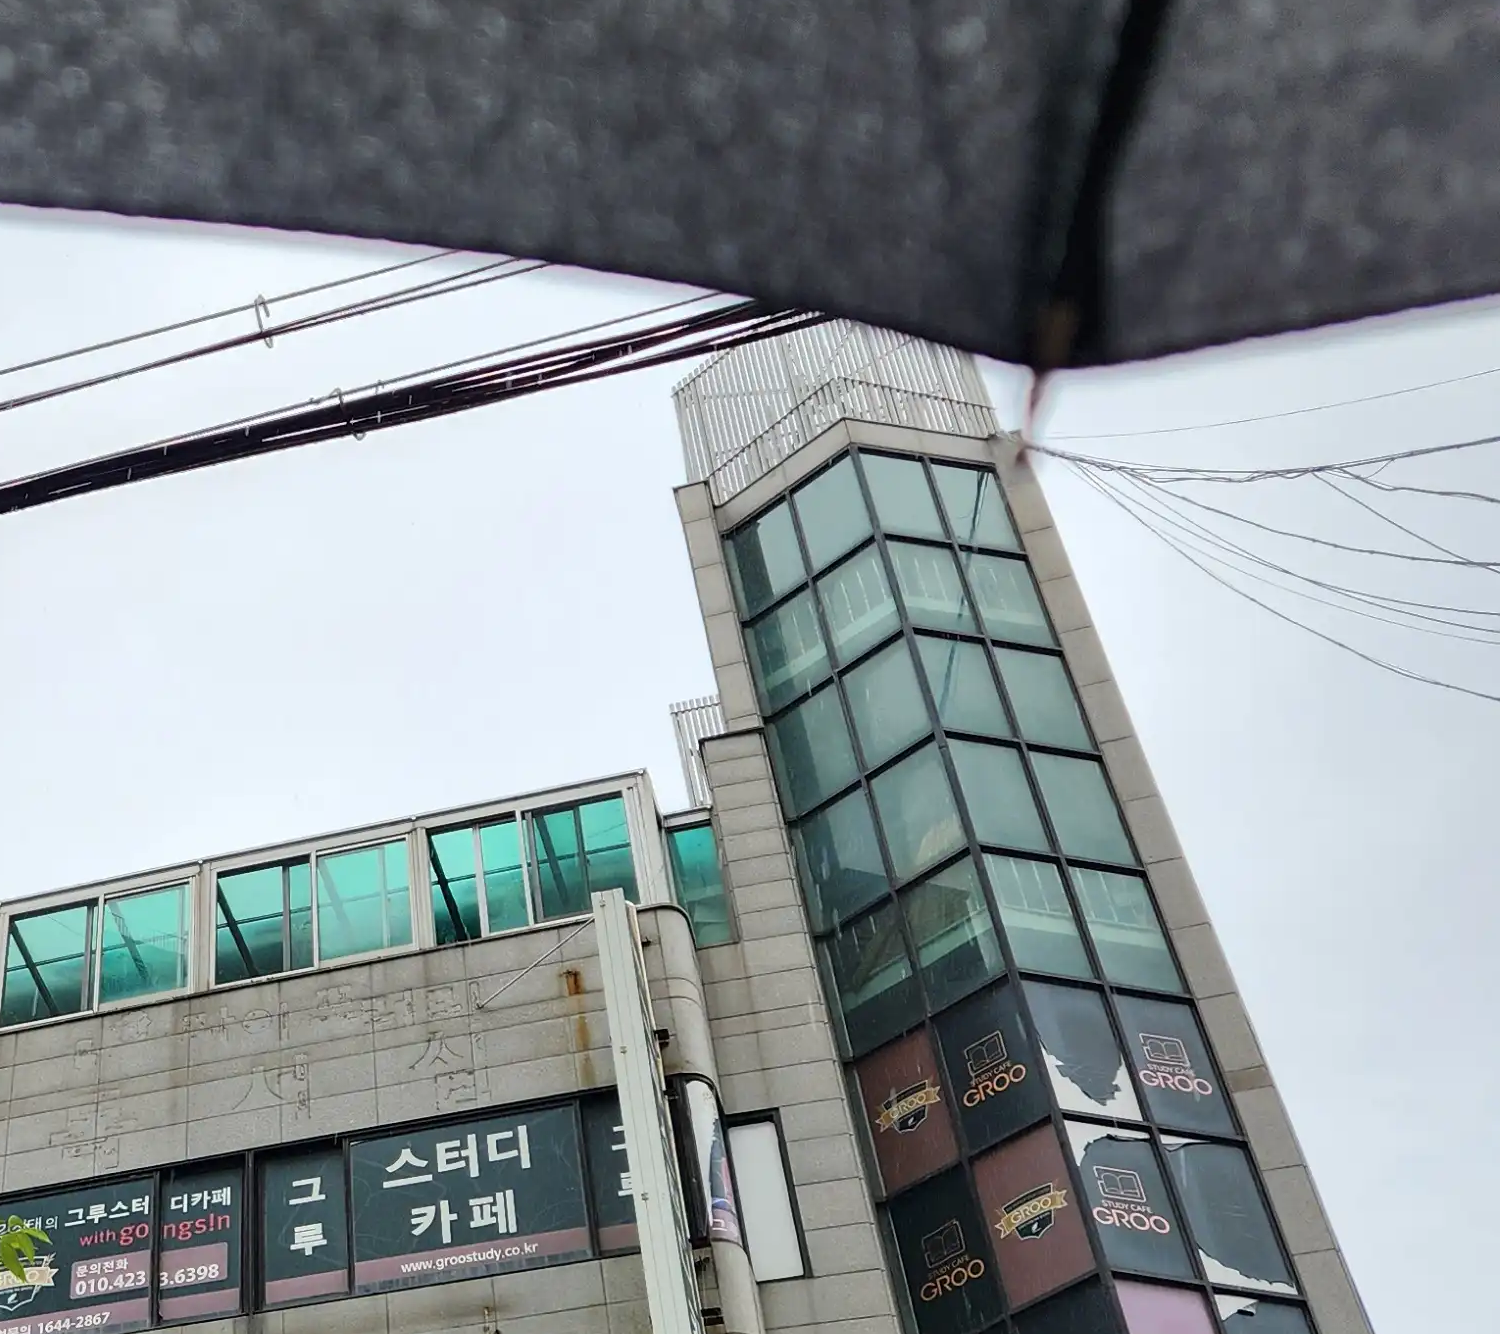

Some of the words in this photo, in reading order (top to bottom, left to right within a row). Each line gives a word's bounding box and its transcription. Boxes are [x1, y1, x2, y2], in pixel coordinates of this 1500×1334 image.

[962, 1063, 1027, 1107] GROO
[1139, 1069, 1213, 1095] GROO
[889, 1093, 927, 1119] GROO
[382, 1124, 531, 1189] 스터디
[410, 1189, 518, 1245] 카페
[1010, 1196, 1052, 1225] GROO
[1092, 1204, 1171, 1235] GROO
[1100, 1199, 1129, 1212] STUDY
[79, 1227, 117, 1248] with
[75, 1257, 129, 1278] 문의전화
[399, 1241, 539, 1274] www.groostudy.co.kr
[920, 1258, 985, 1302] GROO
[37, 1312, 111, 1334] 1644-2867
